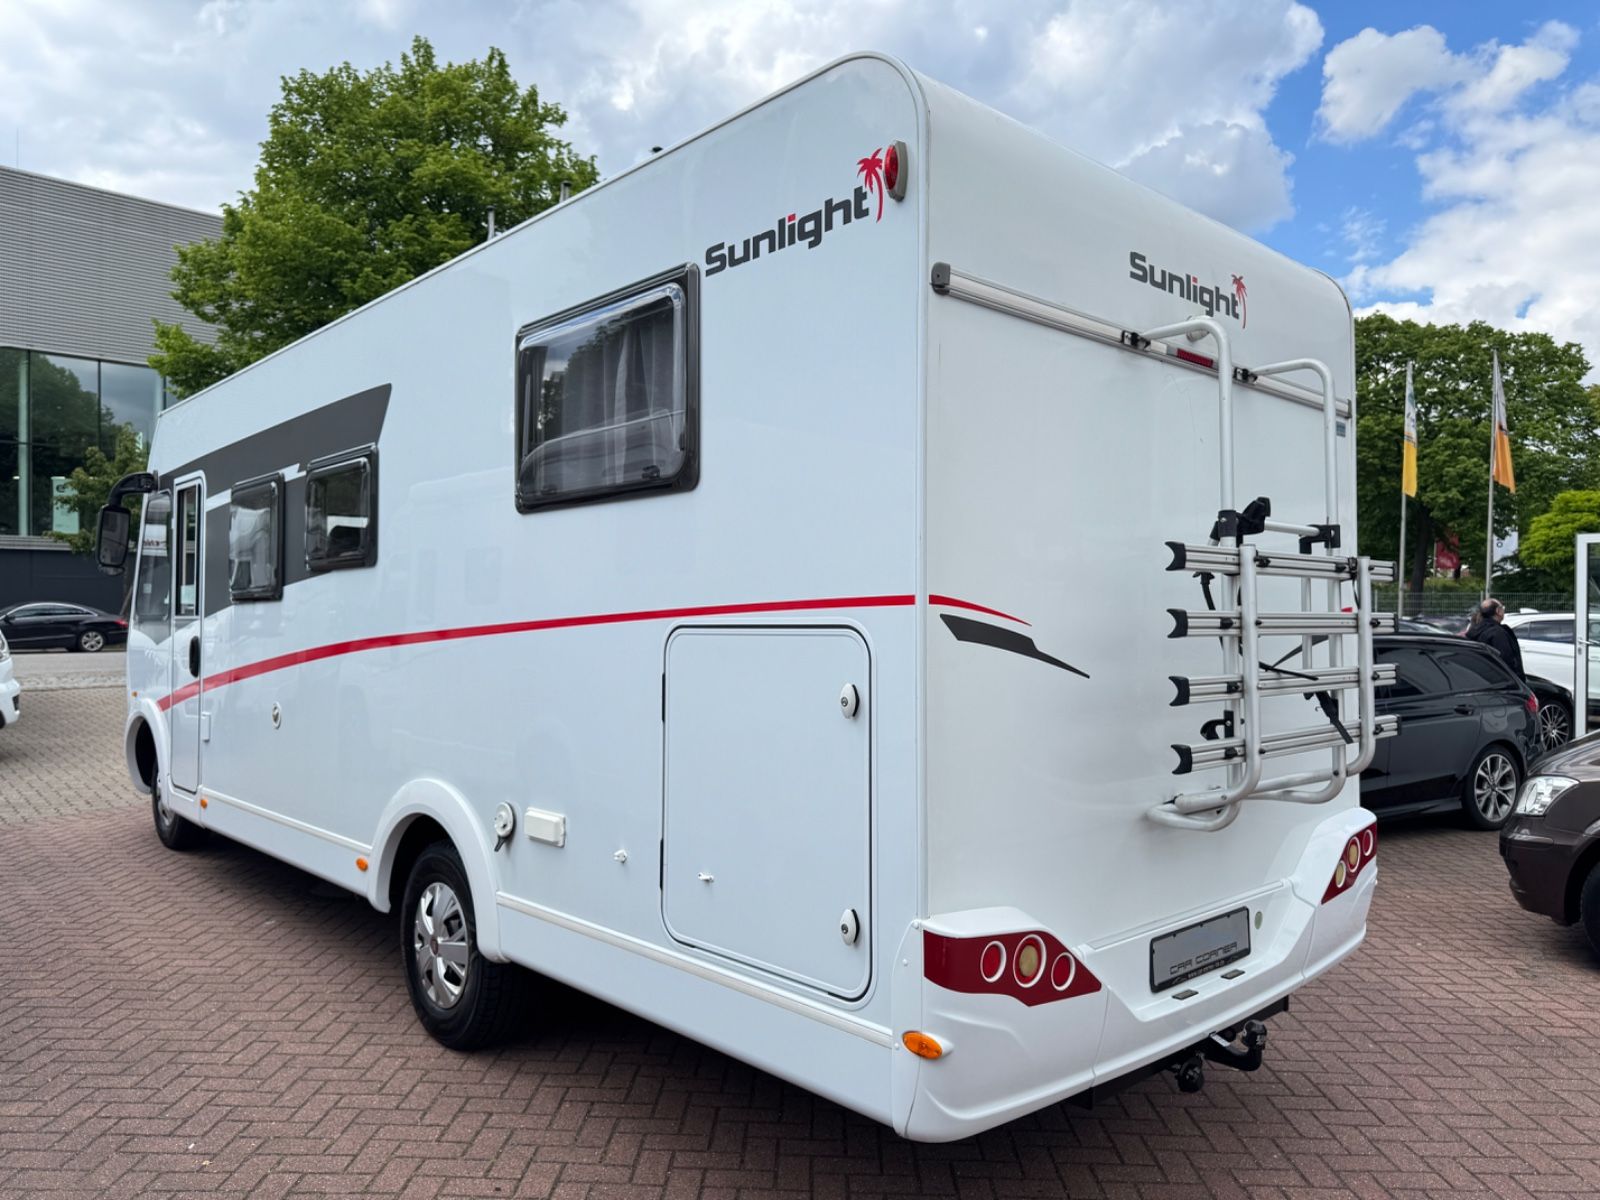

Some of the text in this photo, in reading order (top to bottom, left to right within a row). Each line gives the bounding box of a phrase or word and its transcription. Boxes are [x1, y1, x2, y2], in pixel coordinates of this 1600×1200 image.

[705, 185, 870, 277] Sunlight
[1129, 251, 1240, 320] Sunlight
[1169, 958, 1193, 975] CAR
